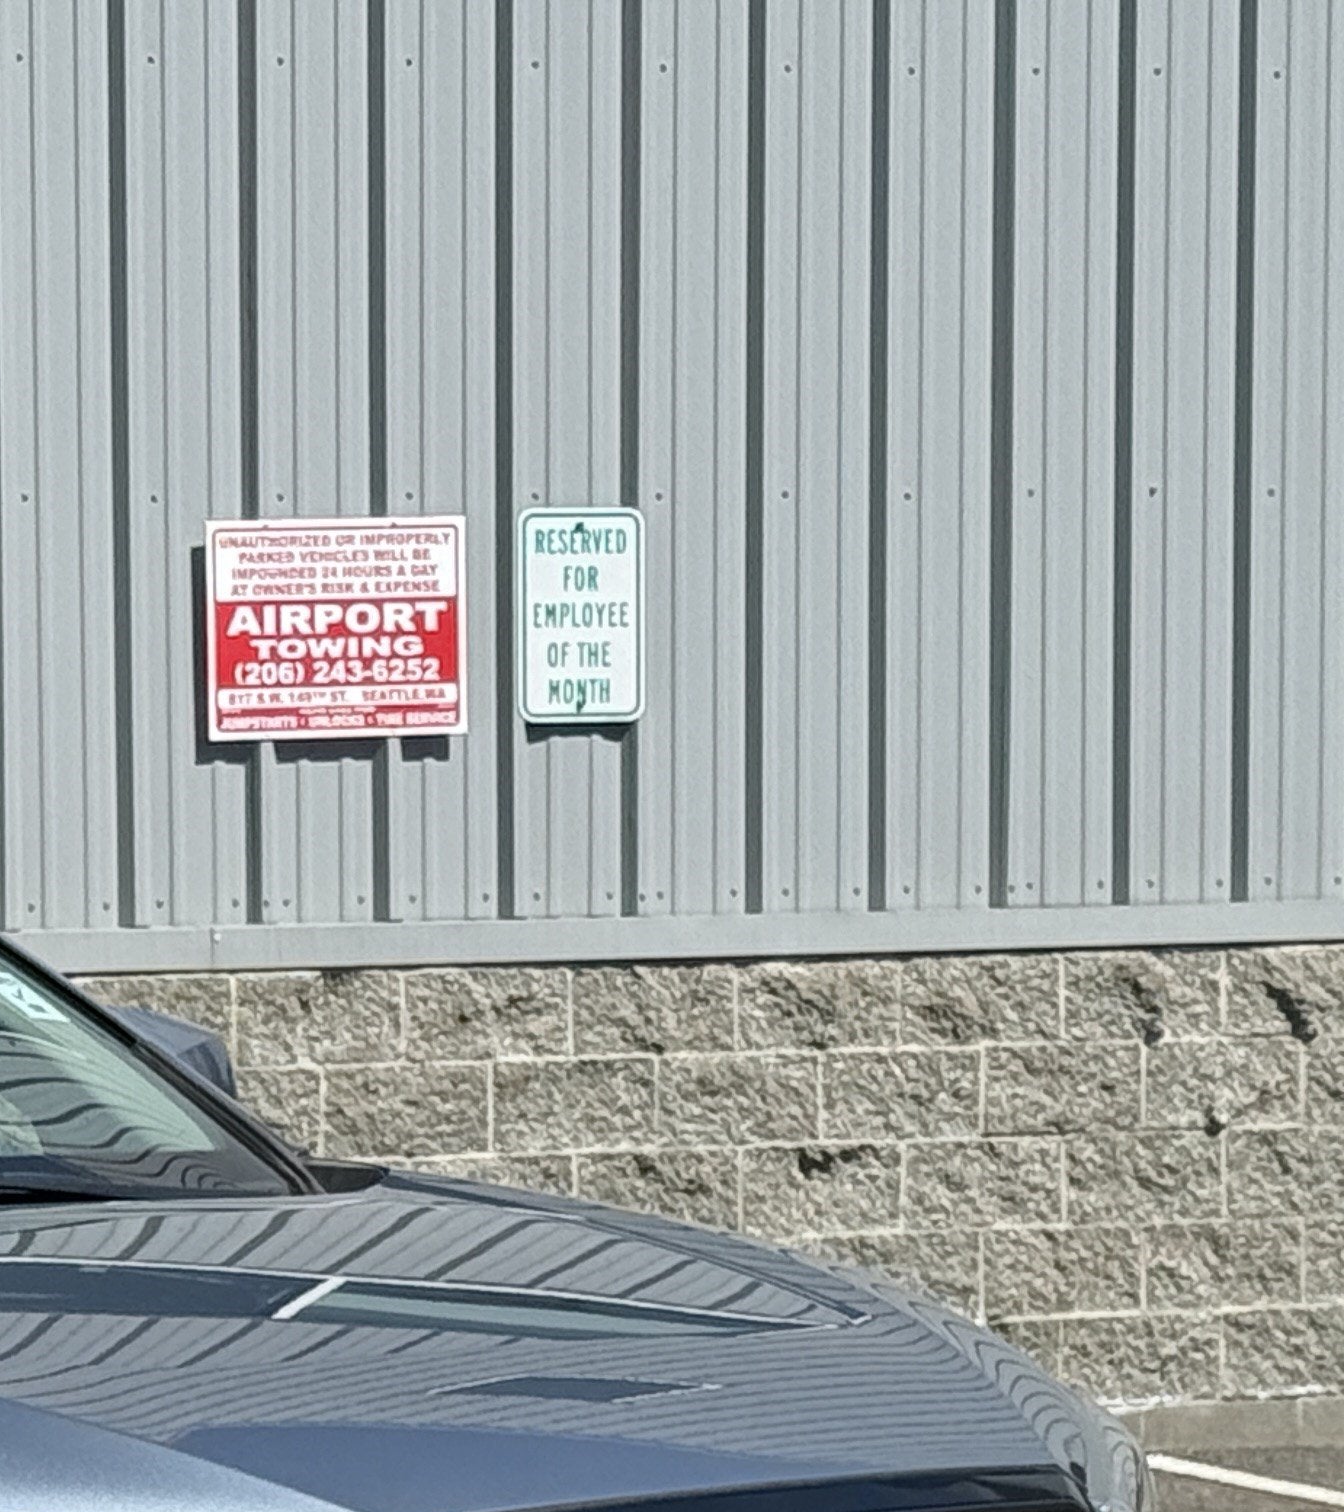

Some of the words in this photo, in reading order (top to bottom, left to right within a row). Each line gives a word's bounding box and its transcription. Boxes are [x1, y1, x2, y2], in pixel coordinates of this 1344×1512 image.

[219, 535, 331, 548] UNAUTHORIZED
[335, 534, 355, 546] OR
[360, 532, 450, 545] IMPROPERLY
[534, 528, 627, 555] RESERVED
[239, 551, 295, 564] PARKED
[299, 549, 369, 563] VEHICLES
[373, 549, 408, 561] WILL
[412, 548, 431, 560] BE
[232, 566, 317, 579] IMPOUNDED
[342, 565, 392, 577] HOURS
[397, 564, 406, 576] A
[411, 564, 438, 576] DAY
[563, 565, 599, 592] FOR
[231, 583, 248, 596] AT
[321, 582, 354, 593] RISK
[360, 581, 369, 593] &
[374, 579, 440, 593] EXPENSE
[226, 602, 448, 637] AIRPORT
[533, 601, 629, 628] EMPLOYEE
[249, 635, 424, 660] TOWING
[547, 641, 571, 668] OF
[576, 641, 612, 668] THE
[234, 660, 305, 686] (206)
[312, 658, 440, 684] 243-6252
[548, 678, 611, 706] MONTH
